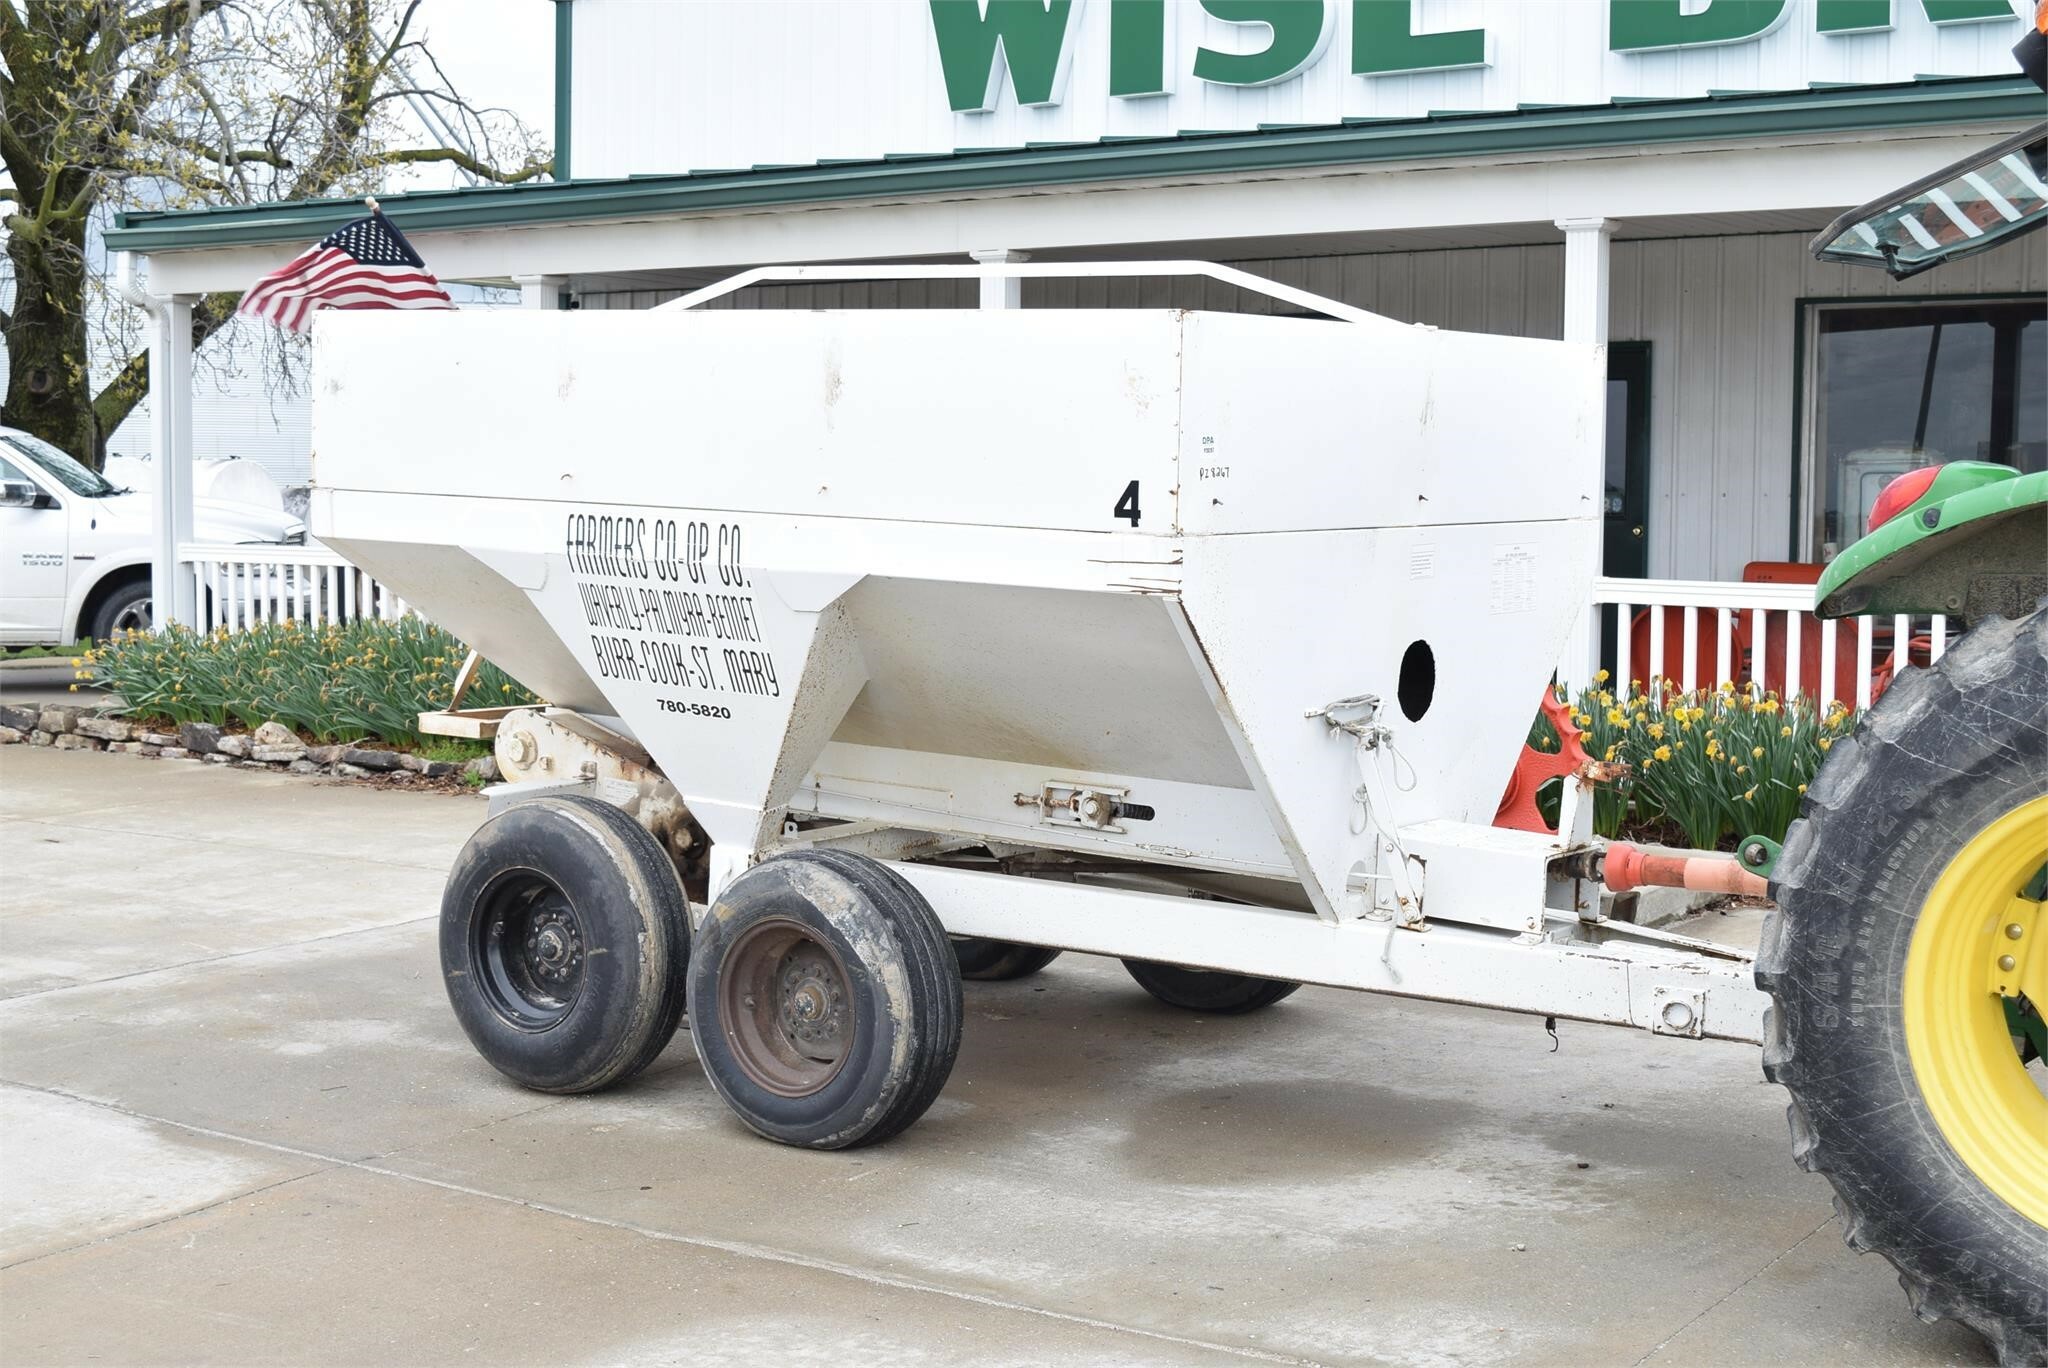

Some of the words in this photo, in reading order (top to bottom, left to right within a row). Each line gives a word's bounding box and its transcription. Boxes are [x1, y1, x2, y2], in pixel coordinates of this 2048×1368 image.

[1114, 480, 1141, 527] 4
[566, 514, 648, 579] FARMERS
[655, 519, 709, 584] CO-OP
[718, 524, 751, 588] CO.
[723, 649, 780, 697] MARY
[656, 699, 731, 719] 780-5820
[1868, 819, 1929, 904] TRACTION
